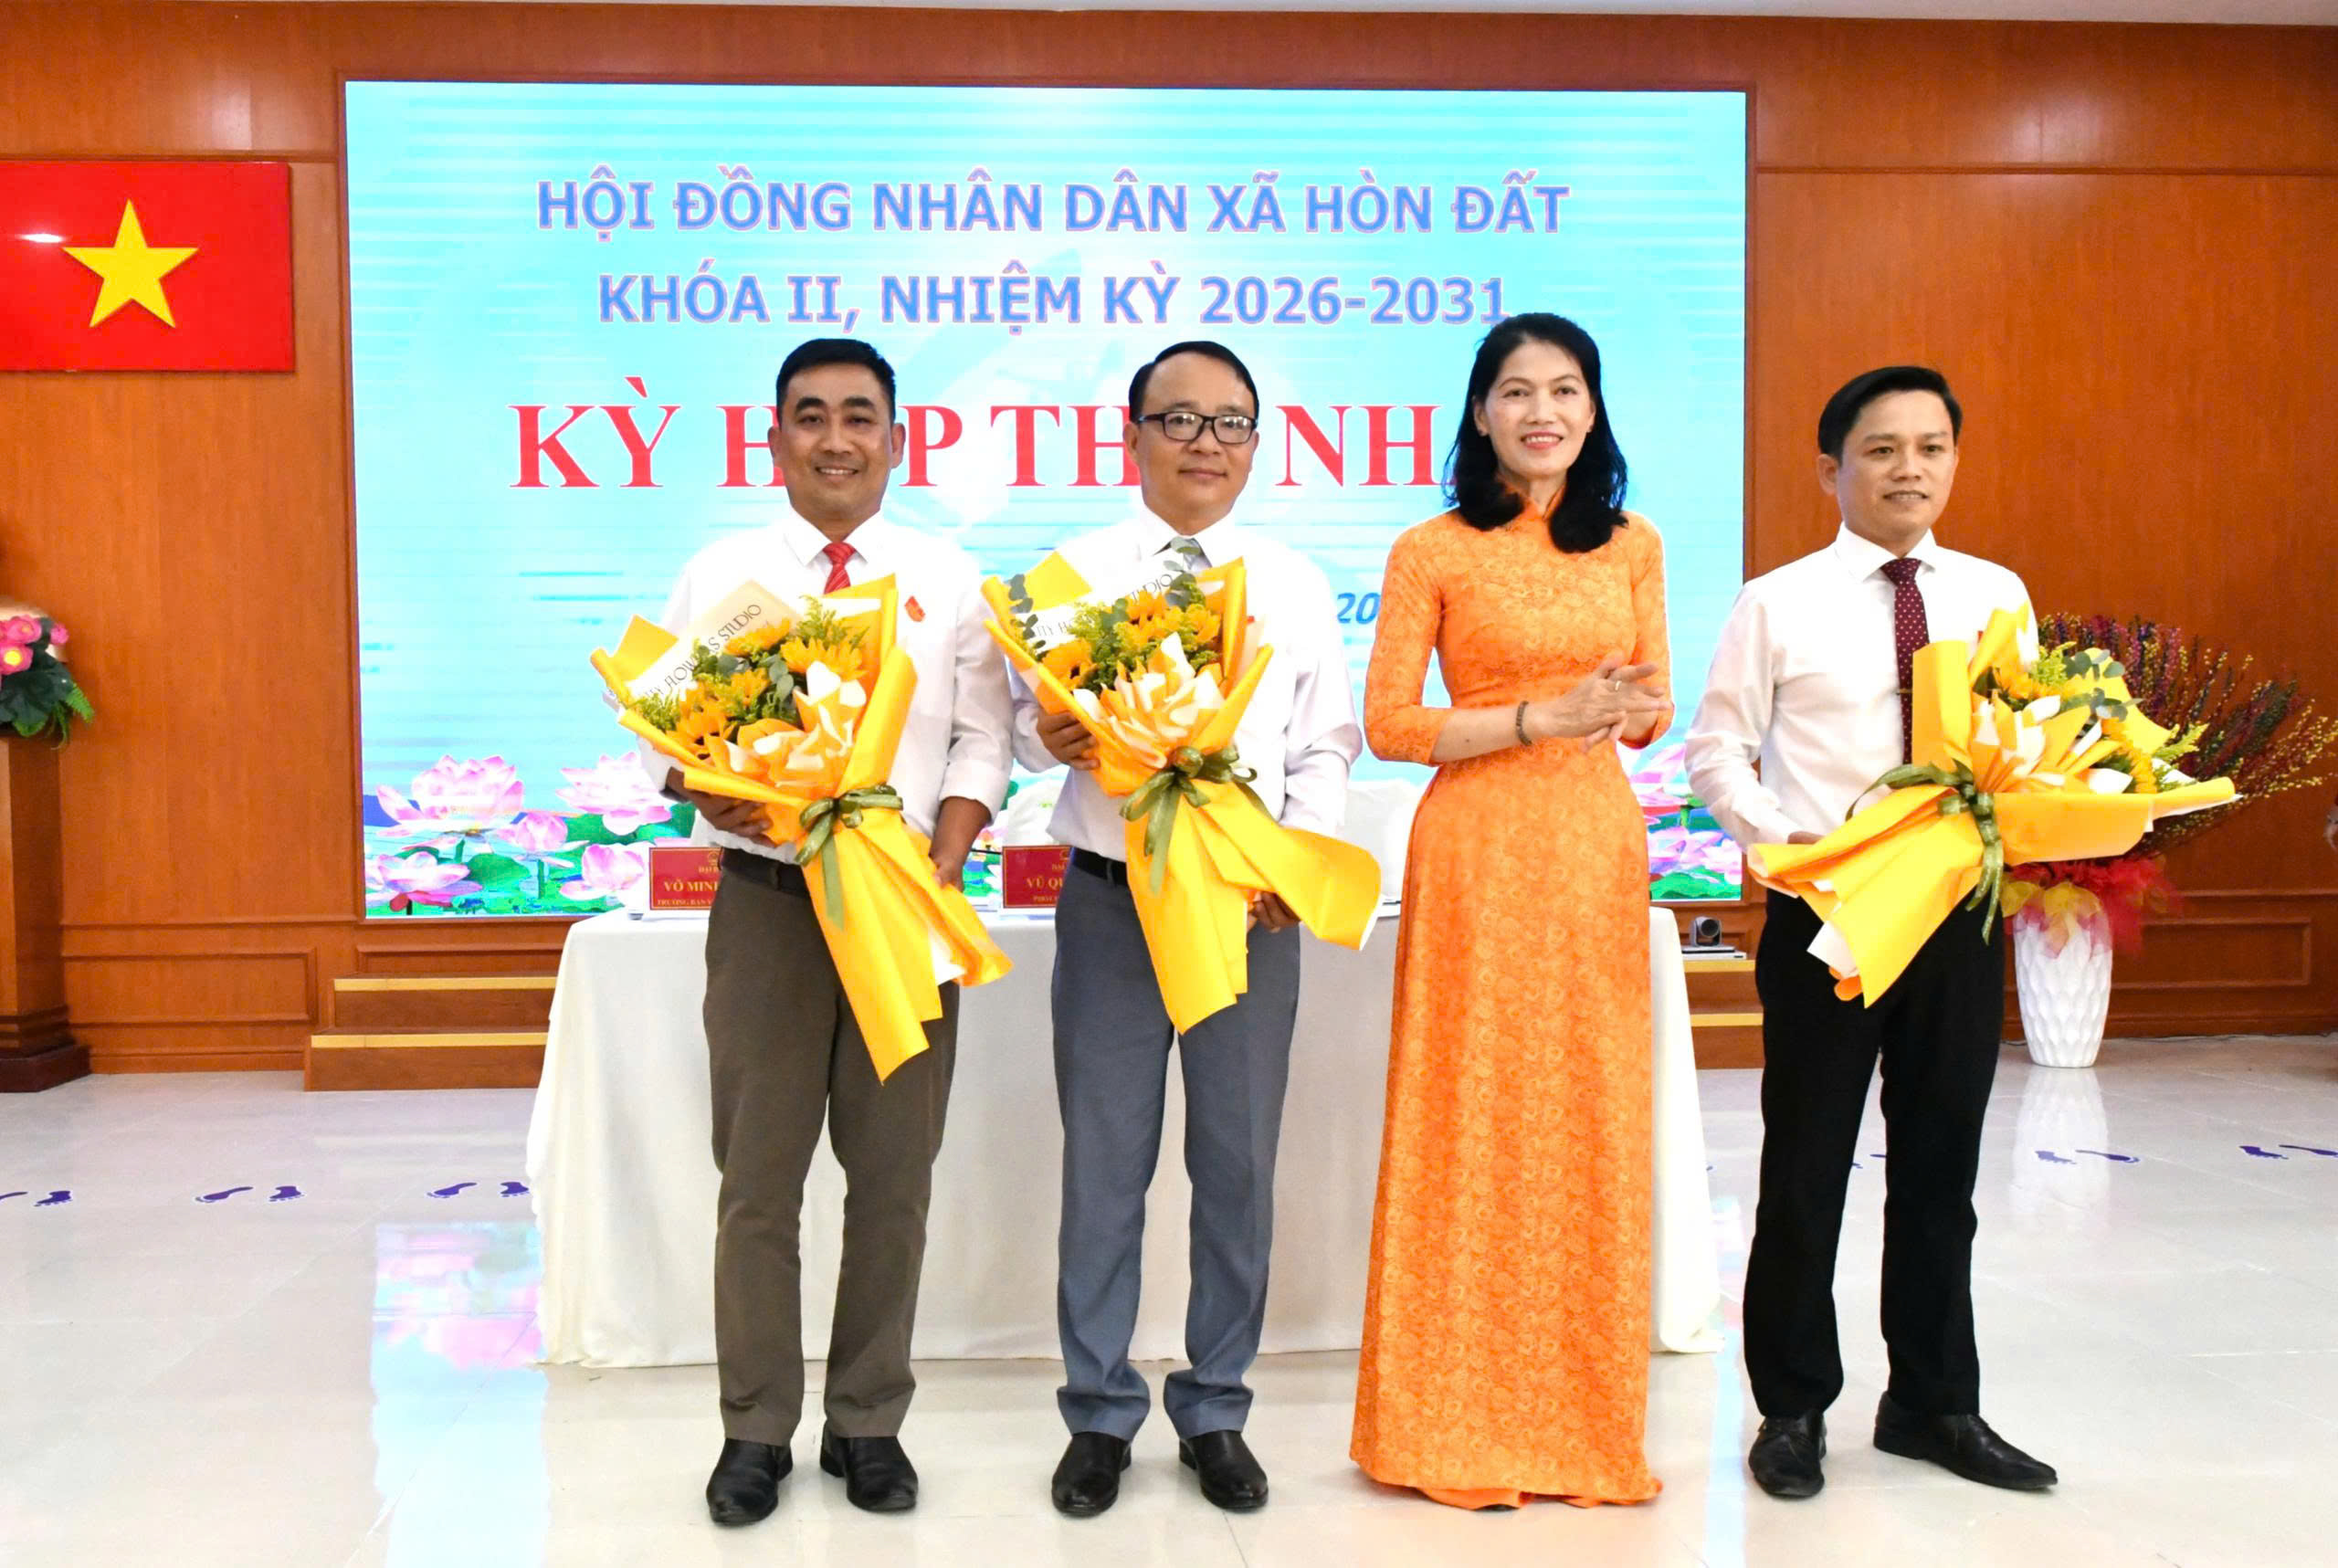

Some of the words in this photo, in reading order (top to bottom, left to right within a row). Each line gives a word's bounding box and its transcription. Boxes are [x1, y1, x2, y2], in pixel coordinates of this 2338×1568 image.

[538, 165, 655, 242] HỘI
[673, 165, 851, 232] ĐỒNG
[873, 168, 1043, 232] NHÂN
[1065, 168, 1187, 233] DÂN
[1206, 171, 1287, 233] XÃ
[1306, 169, 1432, 234] HÒN
[1450, 170, 1570, 234] ĐẤT
[599, 258, 771, 323] KHÓA
[787, 276, 860, 332] II,
[881, 259, 1081, 336] NHIỆM
[1103, 260, 1181, 325] KỲ
[1200, 276, 1511, 325] 2026-2031
[509, 376, 681, 488] KỲ
[716, 405, 963, 488] HP
[991, 405, 1142, 488] TH
[1275, 405, 1456, 488] NH
[718, 604, 762, 641] STUDIO
[1336, 592, 1383, 625] 20
